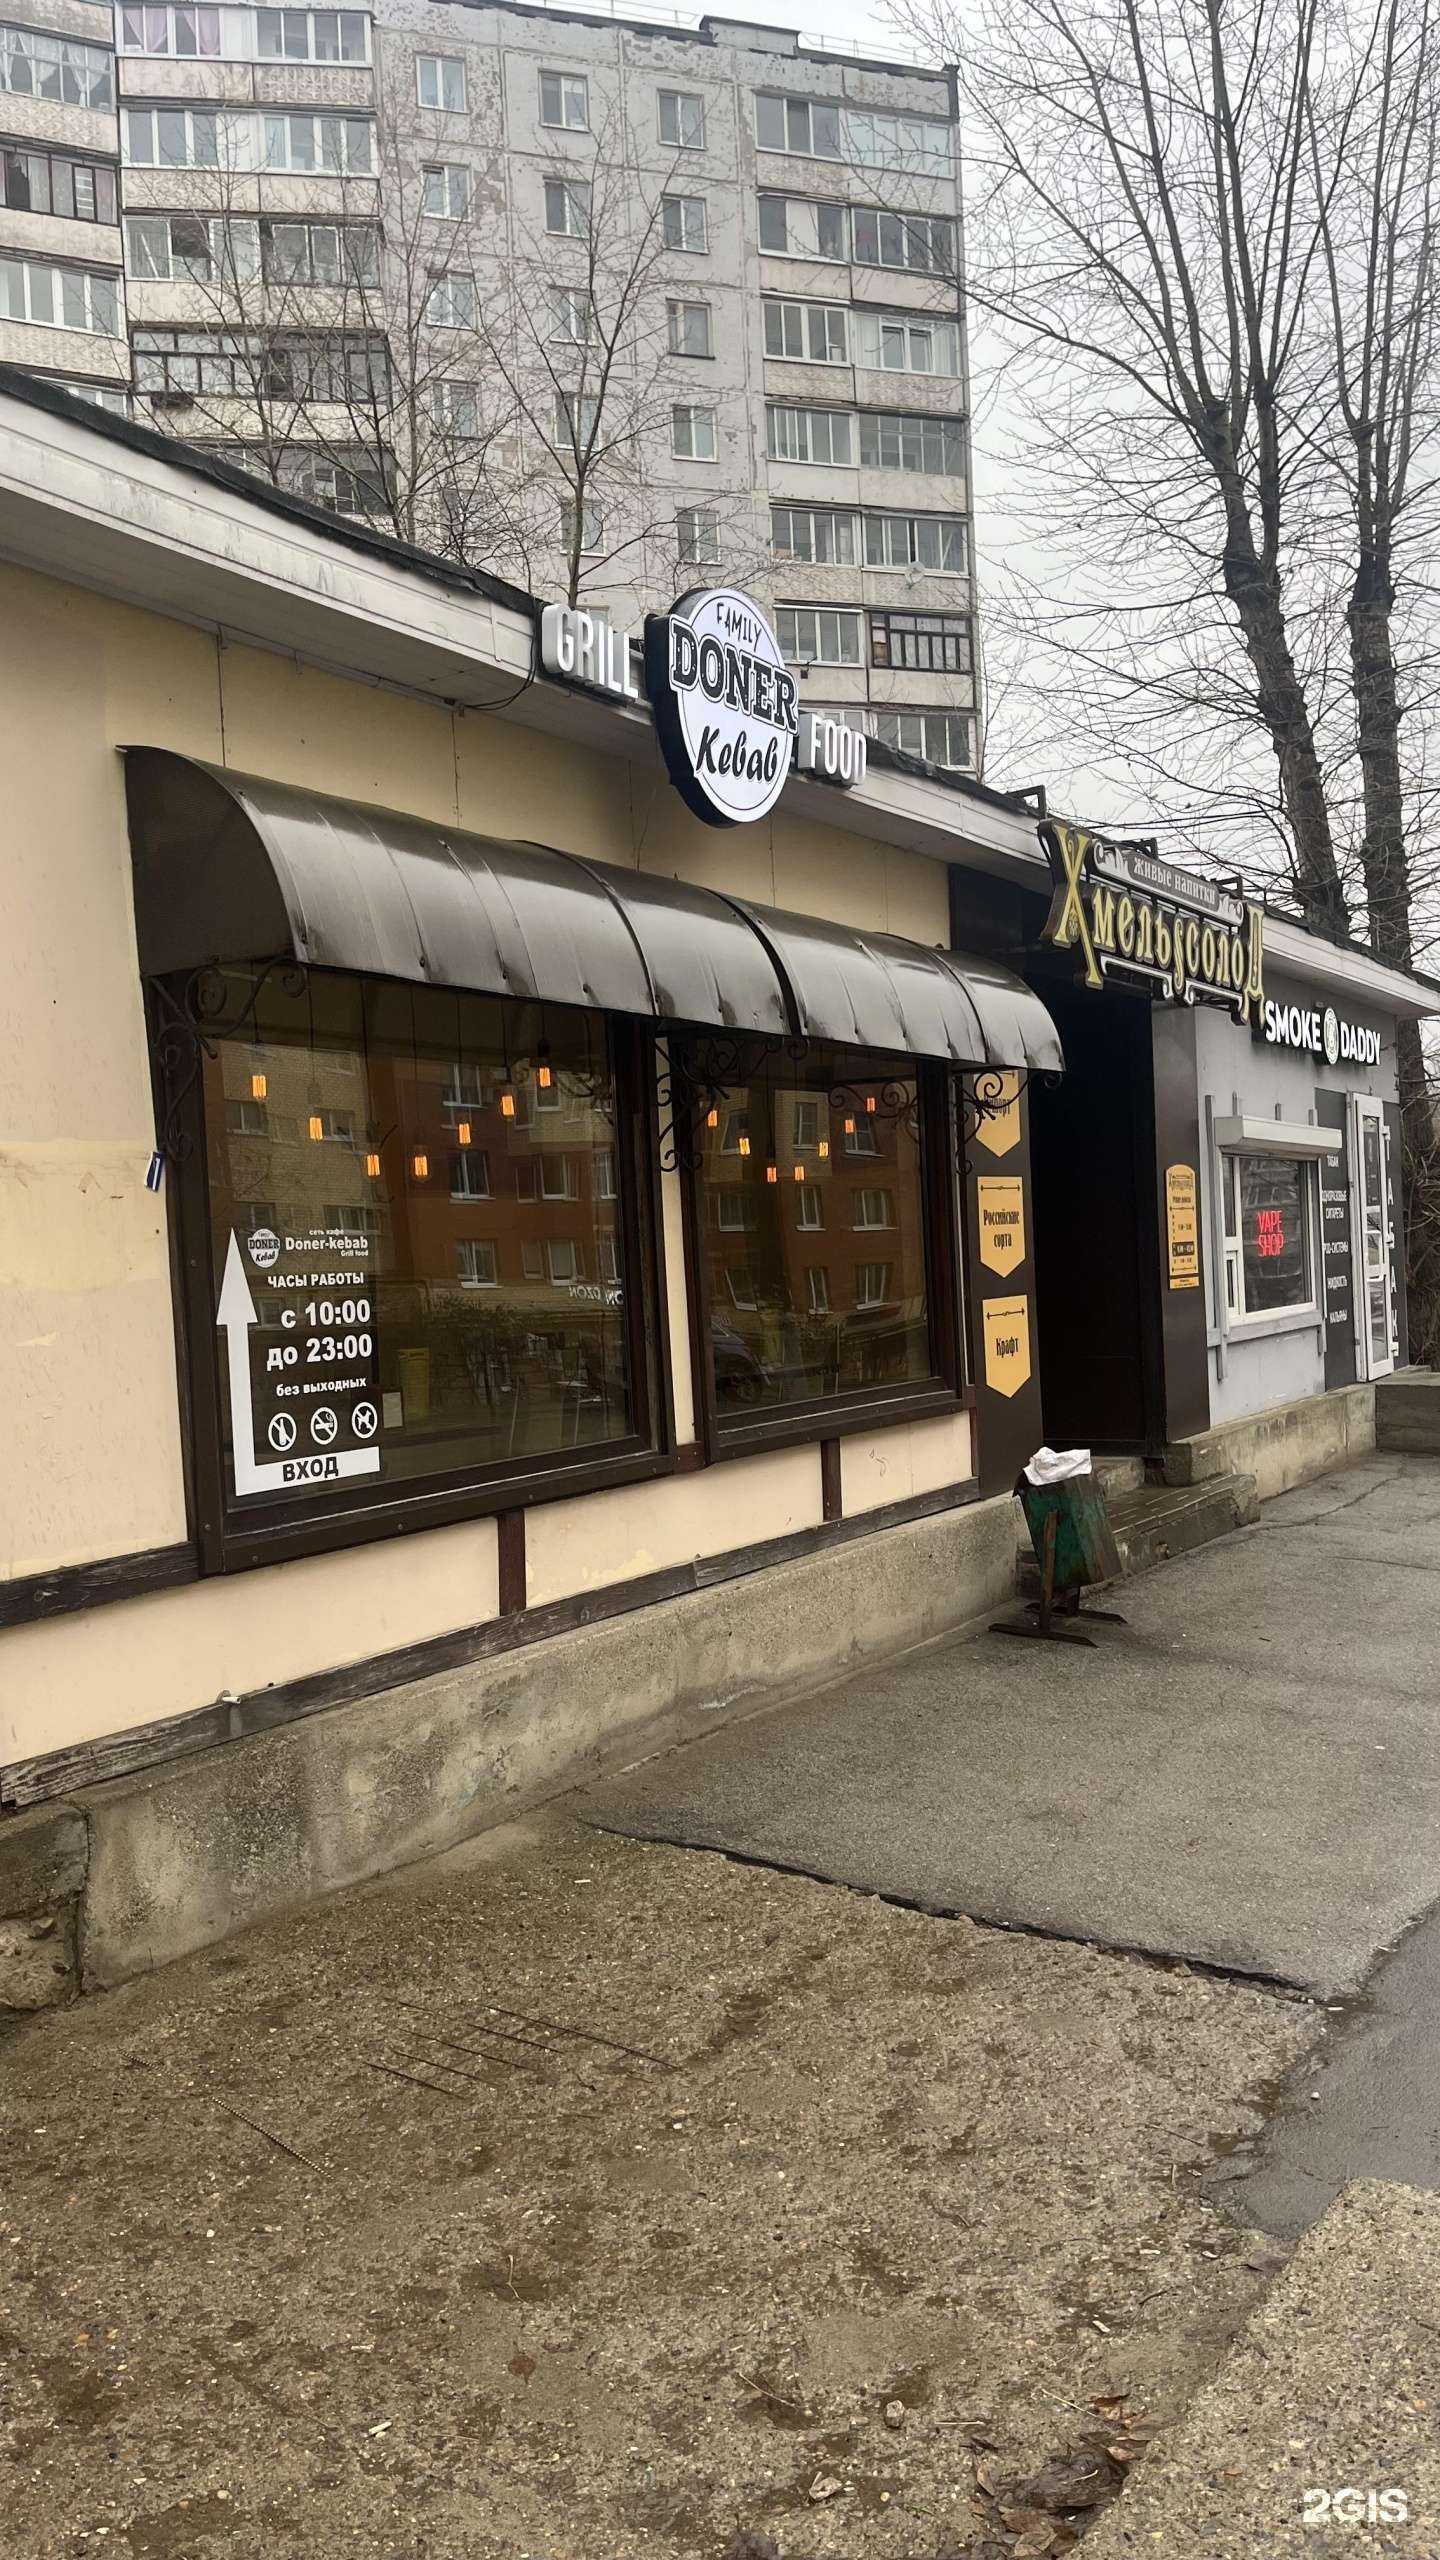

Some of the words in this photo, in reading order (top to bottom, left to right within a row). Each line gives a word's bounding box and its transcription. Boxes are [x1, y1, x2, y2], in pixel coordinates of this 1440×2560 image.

[716, 603, 761, 652] FAMILY
[546, 604, 638, 699] GRILL
[671, 618, 797, 733] DONER
[696, 725, 778, 783] Kebab
[809, 714, 867, 784] FOOD
[1174, 873, 1216, 905] напитки
[1265, 1000, 1322, 1051] SMOKE
[1339, 1024, 1381, 1066] DADDY
[1257, 1209, 1283, 1233] VAPE
[249, 1239, 280, 1250] DONER
[1258, 1233, 1284, 1258] SHOP
[267, 1274, 307, 1288] ЧАСЫ
[310, 1272, 364, 1286] РАБОТЫ
[280, 1310, 297, 1328] с
[305, 1299, 371, 1326] 10:00
[266, 1346, 298, 1371] до
[306, 1334, 372, 1362] 23:00
[996, 1336, 1019, 1358] Крафт
[276, 1384, 300, 1396] без
[303, 1378, 367, 1392] выходных
[282, 1456, 339, 1482] ВХОД
